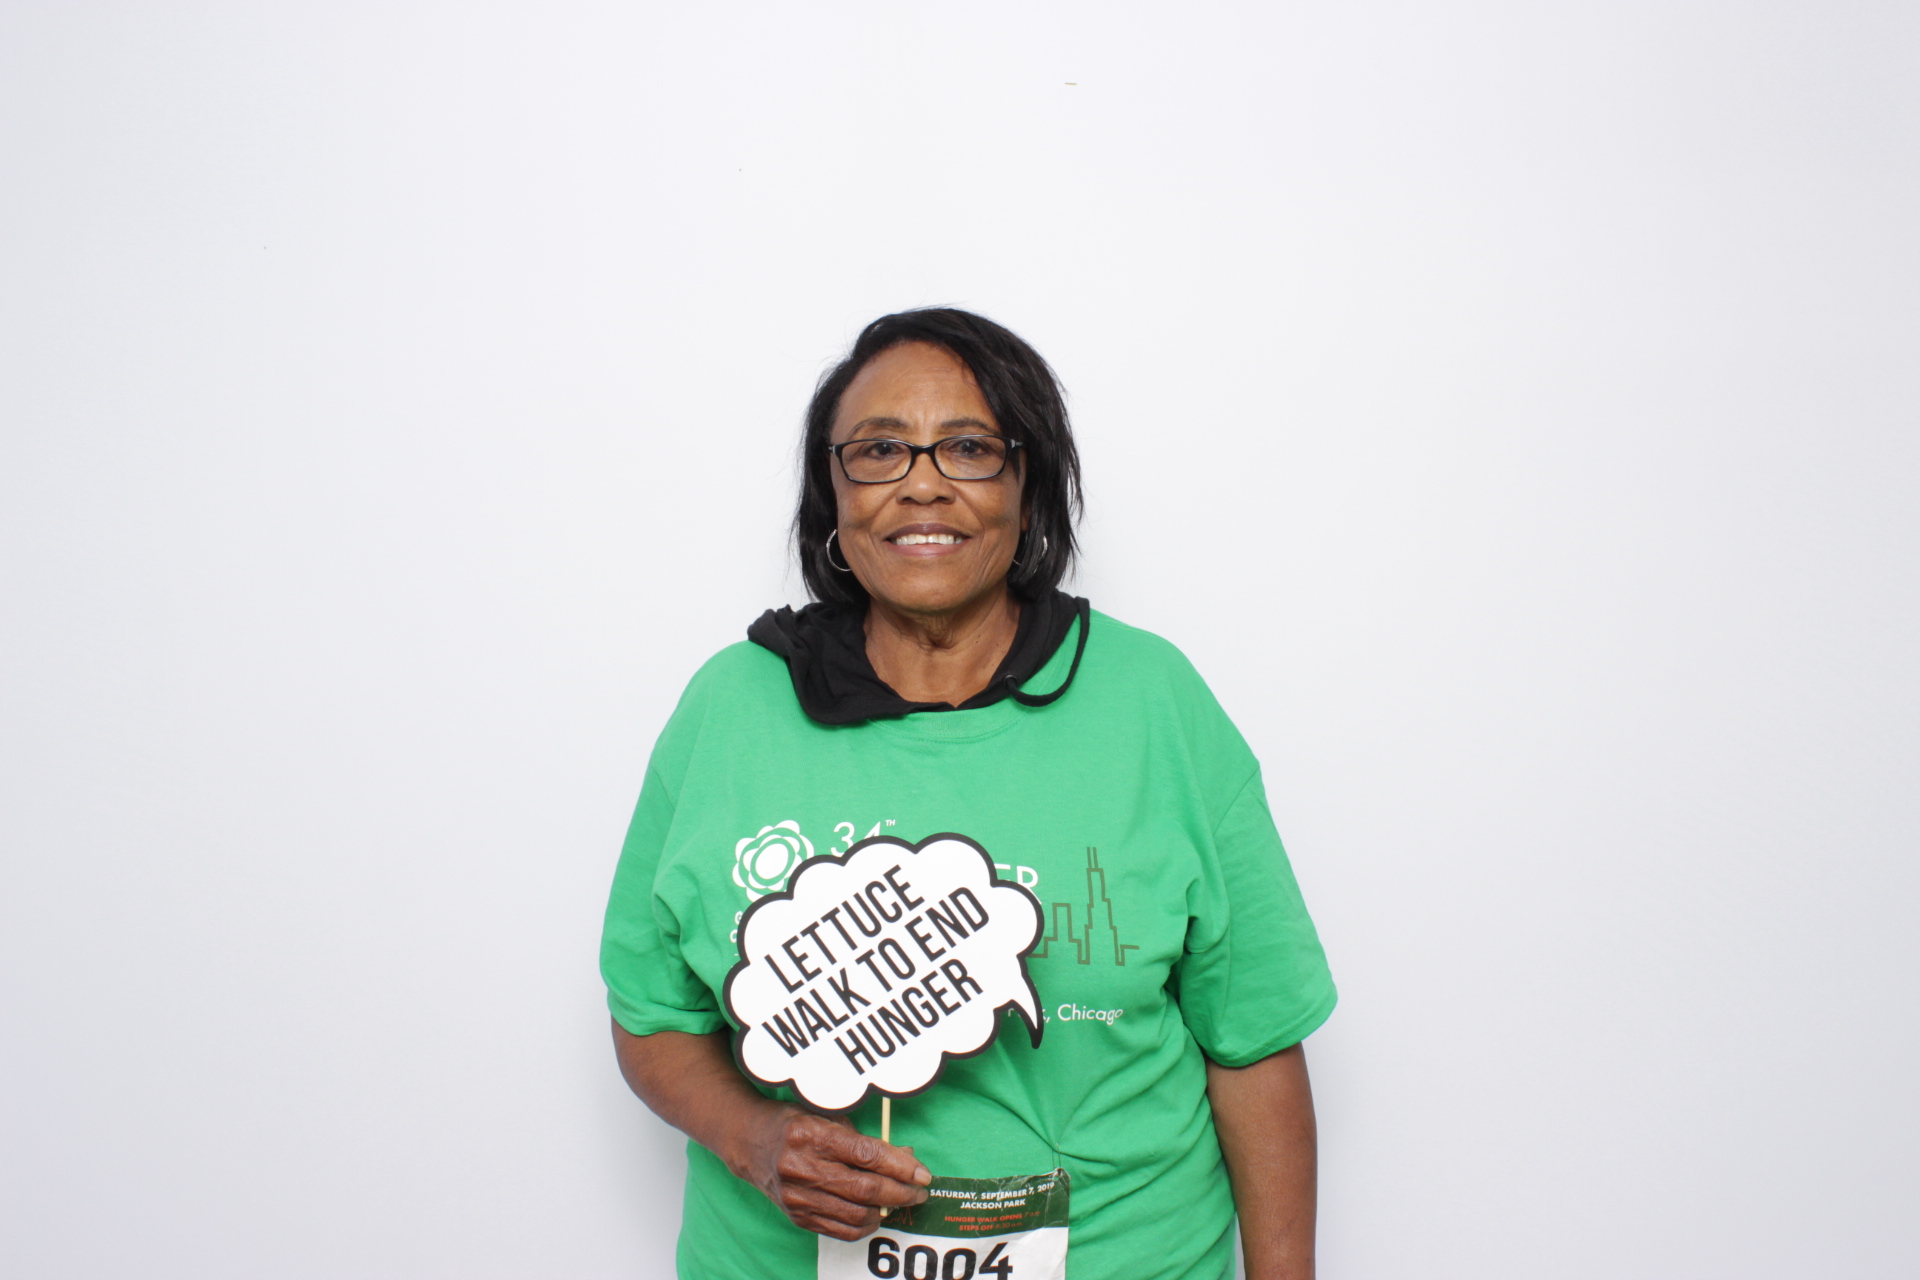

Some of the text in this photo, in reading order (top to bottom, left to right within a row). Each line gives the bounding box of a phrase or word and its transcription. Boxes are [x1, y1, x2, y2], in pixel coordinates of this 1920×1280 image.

[764, 864, 925, 994] LETTUCE
[761, 886, 990, 1058] WALK TO END
[833, 957, 984, 1076] HUNGER
[1057, 1002, 1124, 1026] Chicago
[929, 1181, 1055, 1201] SATURDAY, SEPTEMBER 7, 2019
[960, 1198, 1026, 1210] JACKSON PARK
[944, 1215, 976, 1223] HUNGER
[999, 1213, 1023, 1221] OPENS
[867, 1236, 1013, 1280] 6004
